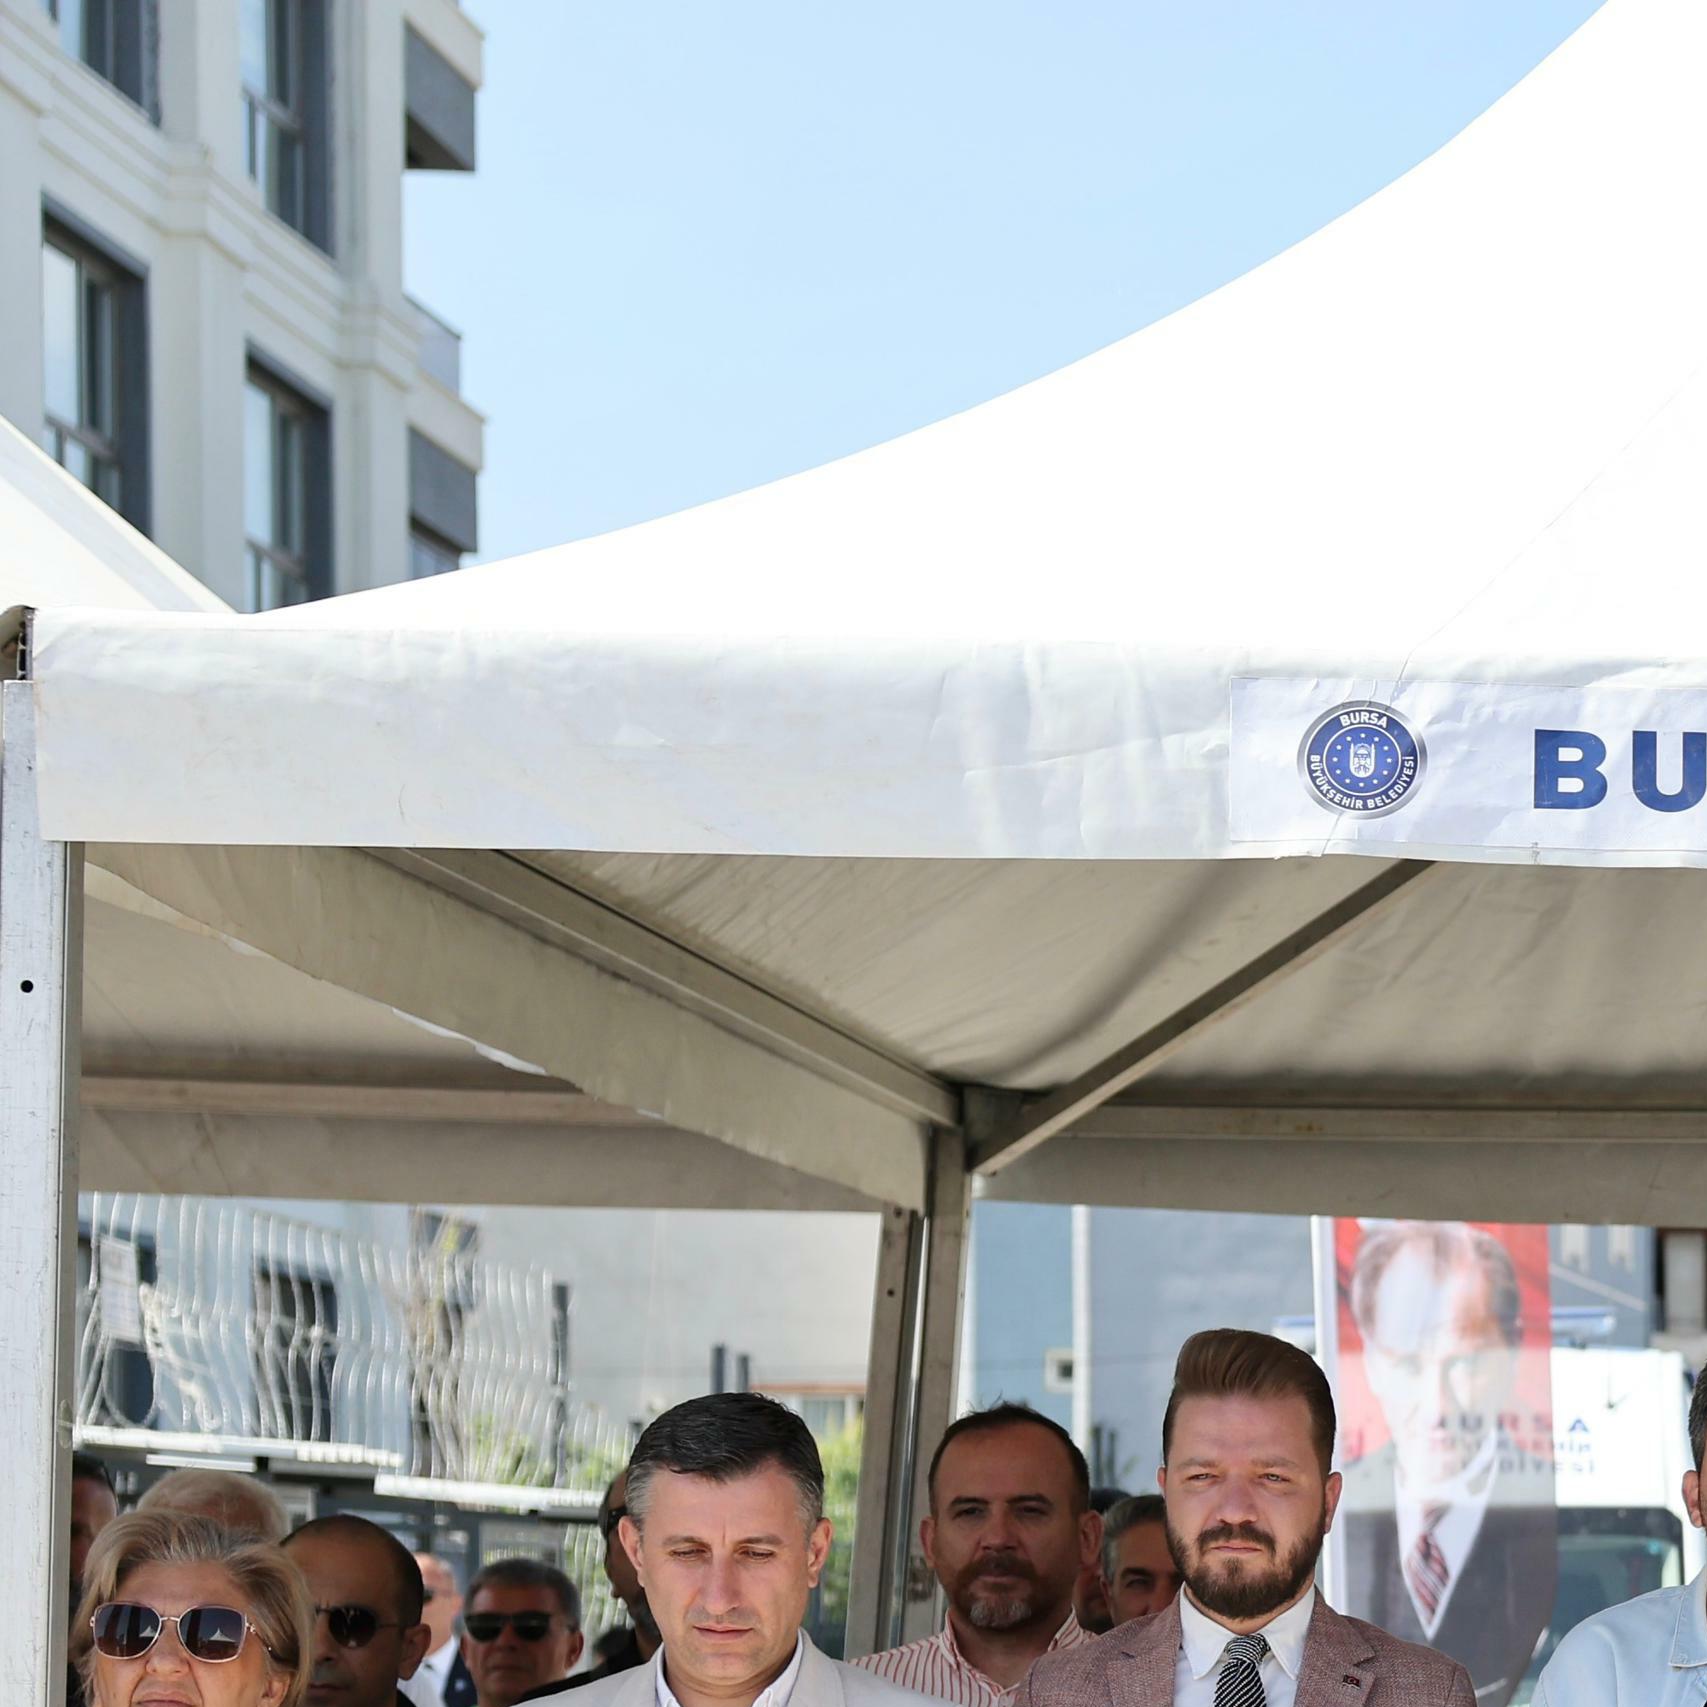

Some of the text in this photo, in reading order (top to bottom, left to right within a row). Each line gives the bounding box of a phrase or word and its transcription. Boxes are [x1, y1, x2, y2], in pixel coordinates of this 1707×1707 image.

[1339, 711, 1389, 729] BURSA
[1310, 754, 1415, 809] BÜYÜKŞEHİR BELEDİYESİ
